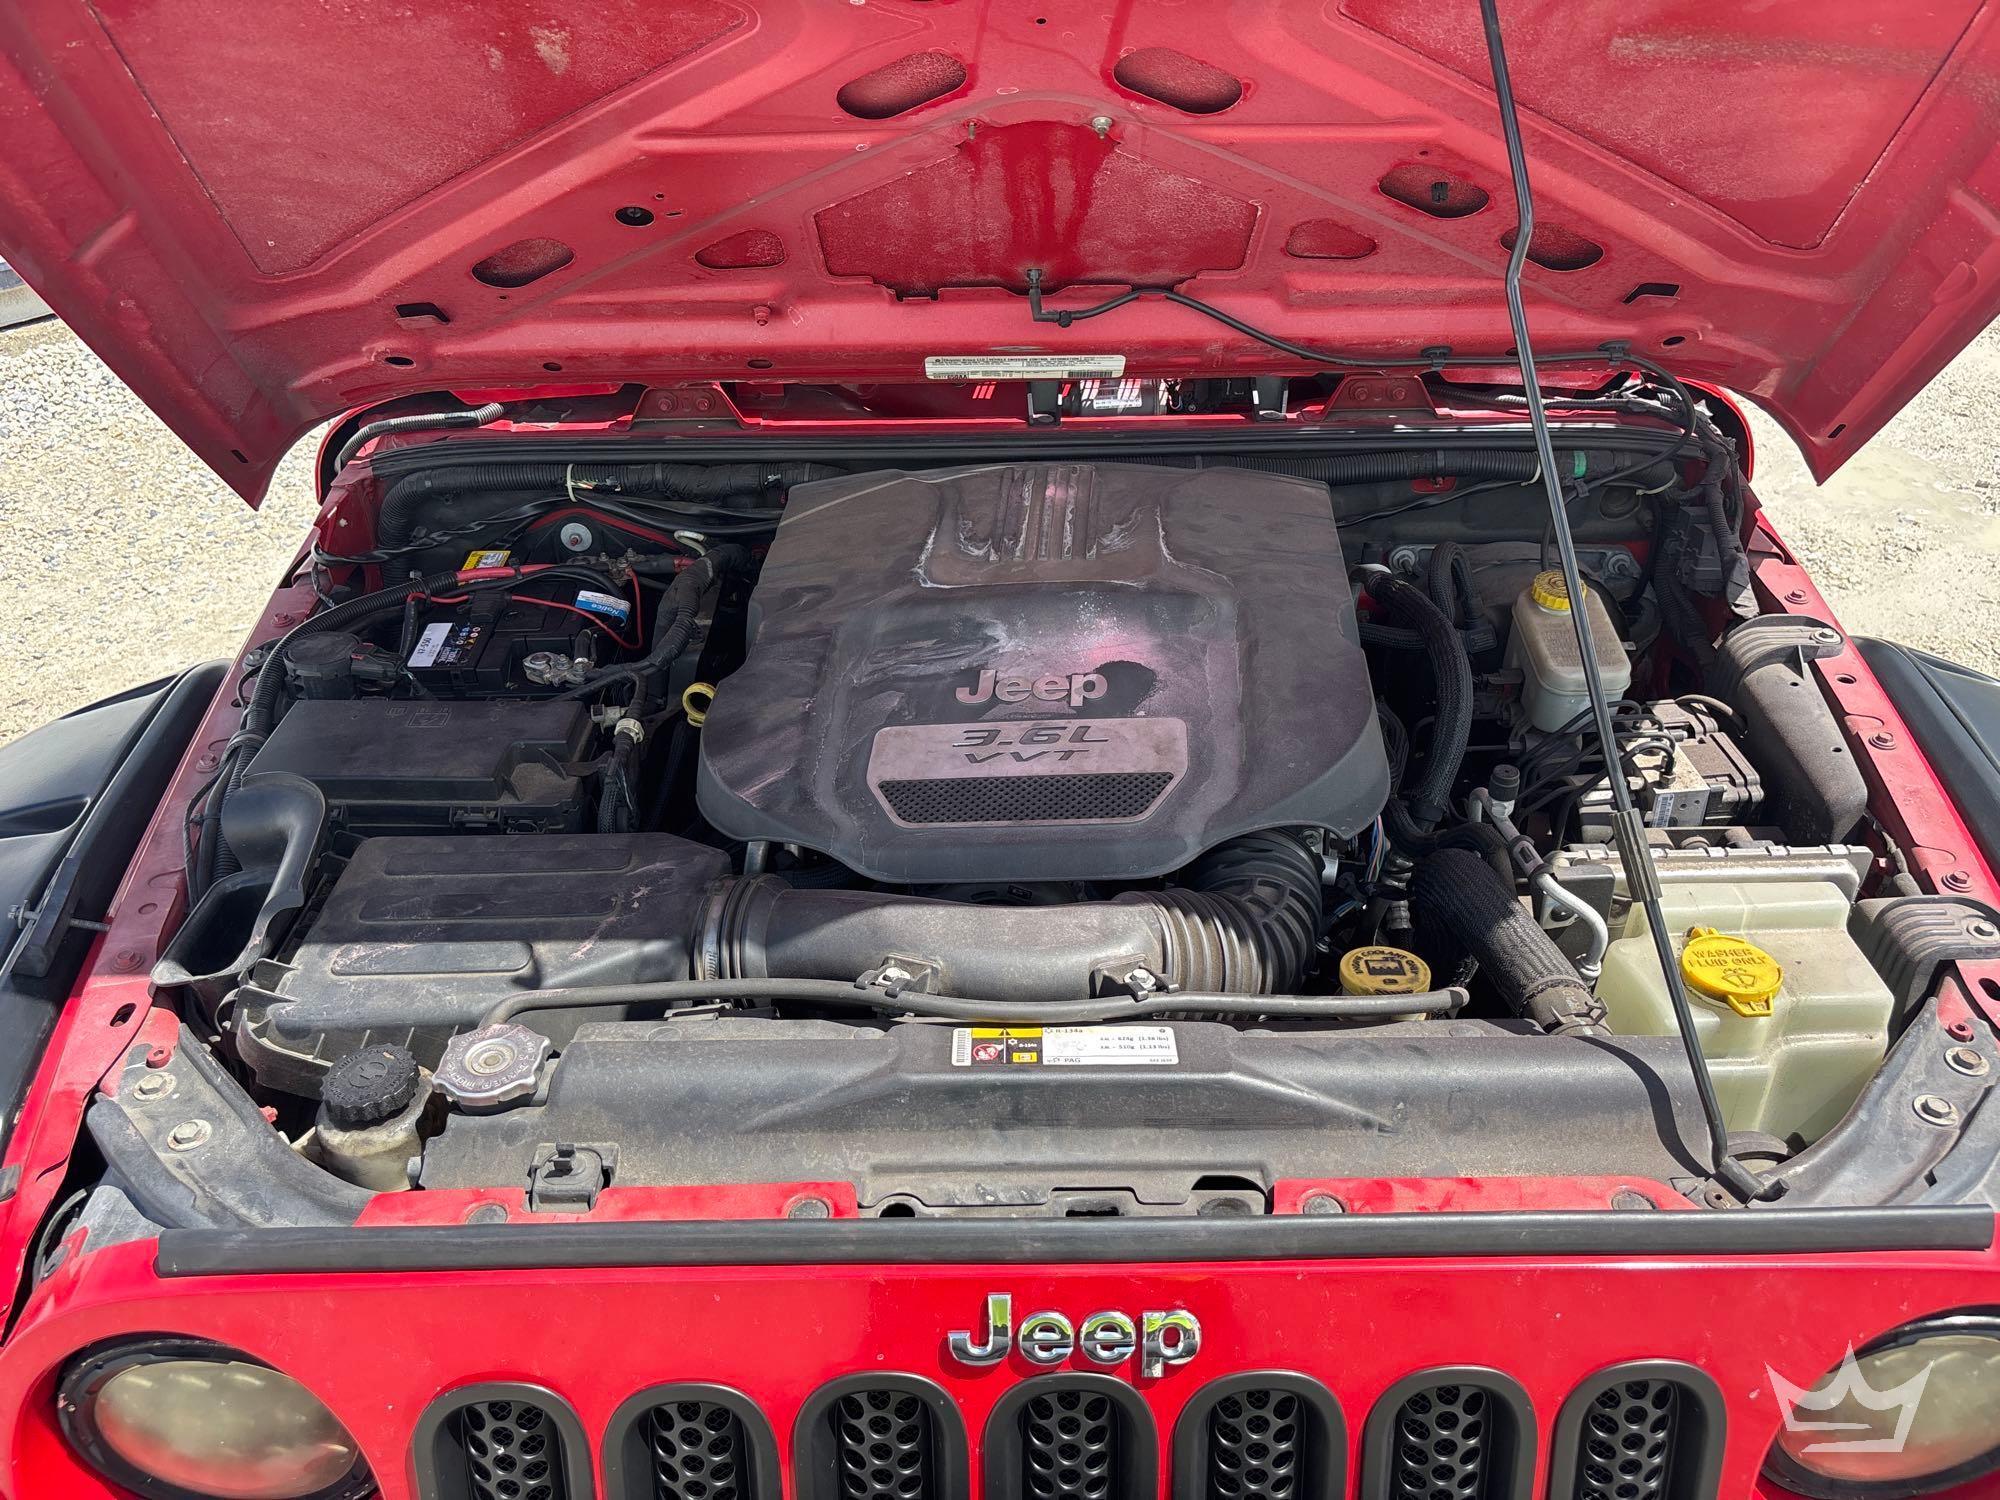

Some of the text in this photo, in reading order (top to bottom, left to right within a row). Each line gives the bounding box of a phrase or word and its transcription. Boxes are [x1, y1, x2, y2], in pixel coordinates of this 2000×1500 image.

[955, 669, 1108, 707] Jeep
[952, 725, 1109, 748] 3.6L
[961, 749, 1090, 764] VVT
[1361, 949, 1408, 960] COOLANT
[1692, 947, 1754, 958] WASHER
[1687, 956, 1767, 967] FLUID ONLY
[947, 1291, 1202, 1378] Jeep
